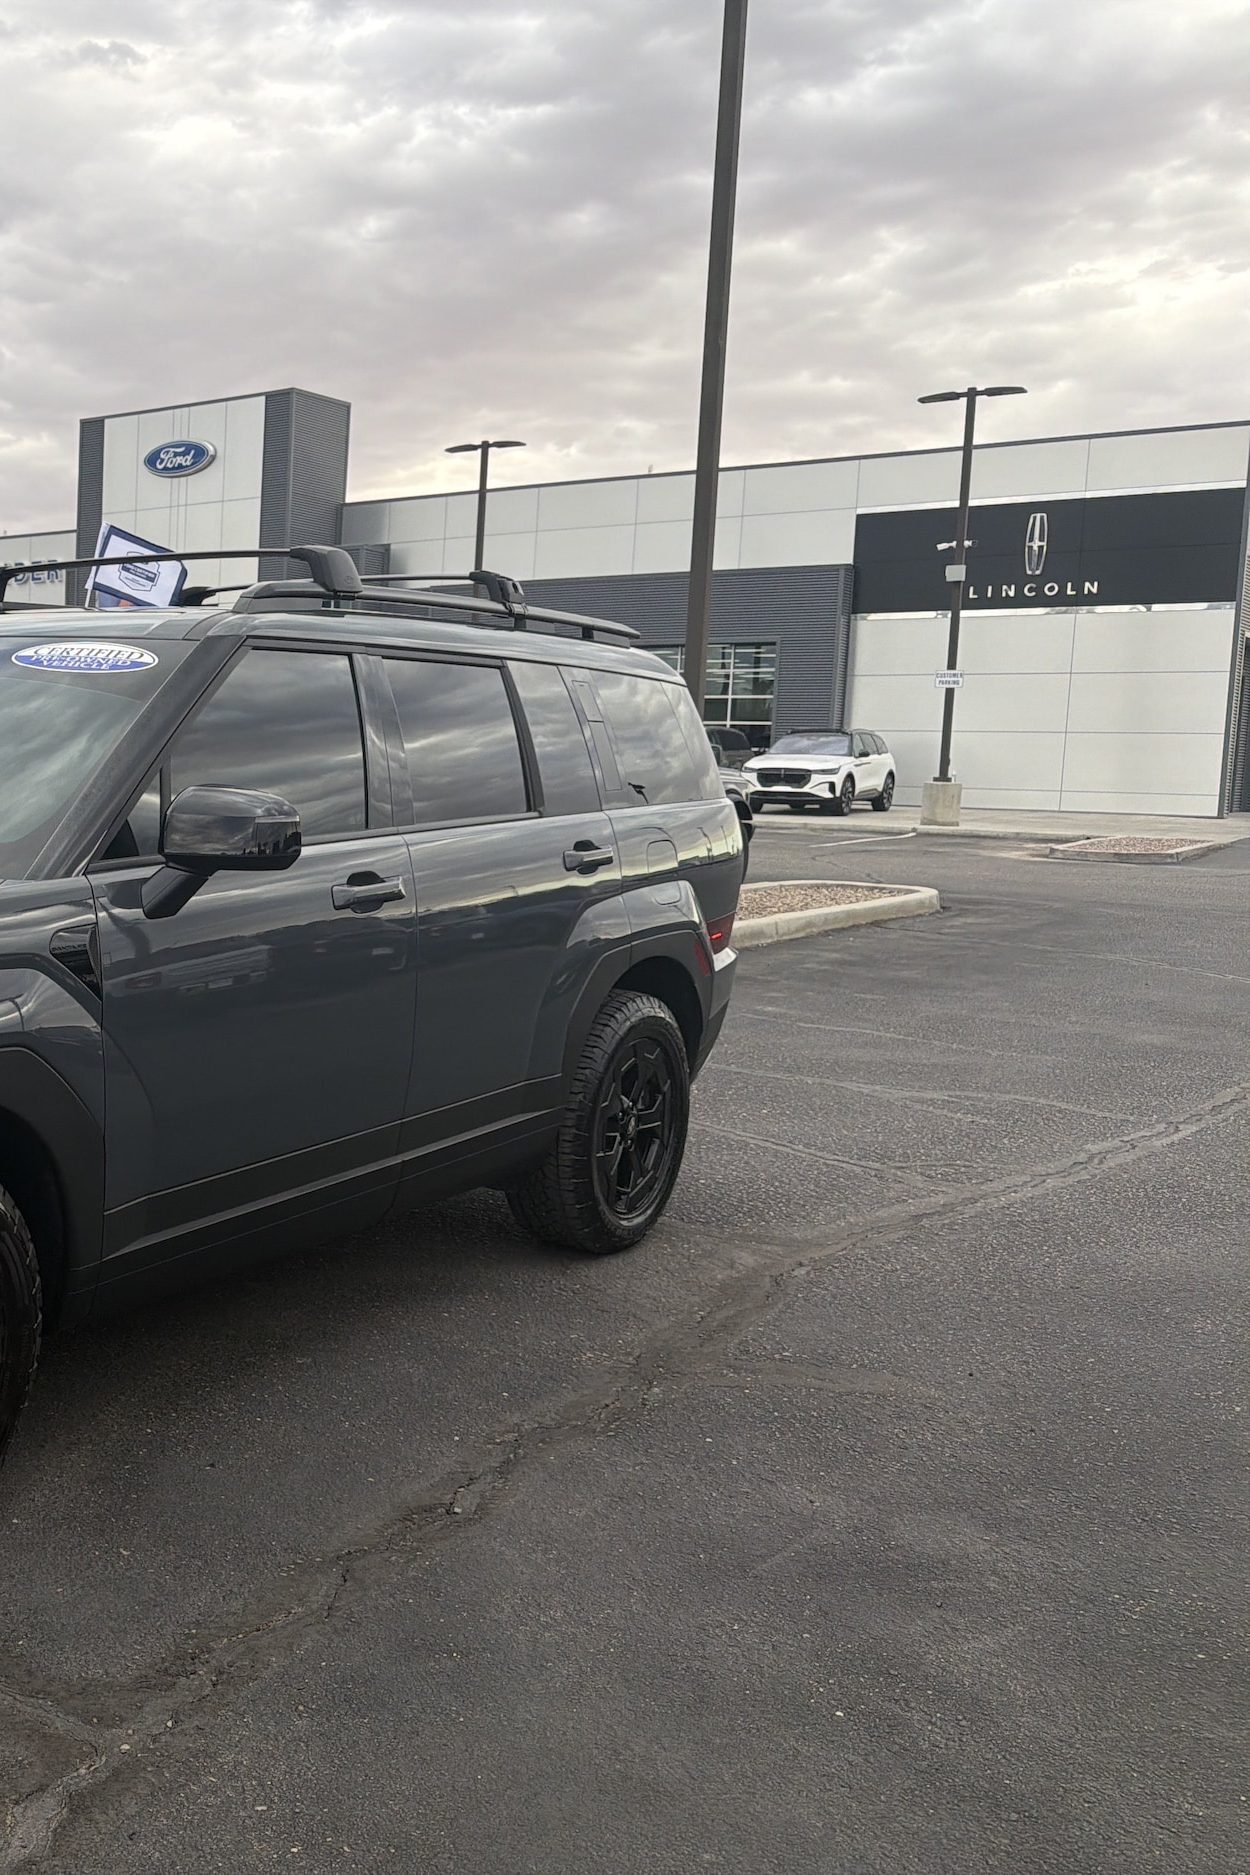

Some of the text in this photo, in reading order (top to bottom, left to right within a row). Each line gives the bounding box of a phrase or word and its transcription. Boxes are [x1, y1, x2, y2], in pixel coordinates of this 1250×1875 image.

[156, 446, 196, 470] Ford
[969, 581, 1099, 599] LINCOLN
[34, 646, 145, 661] CERTIFIED
[42, 660, 112, 670] VEHICLE
